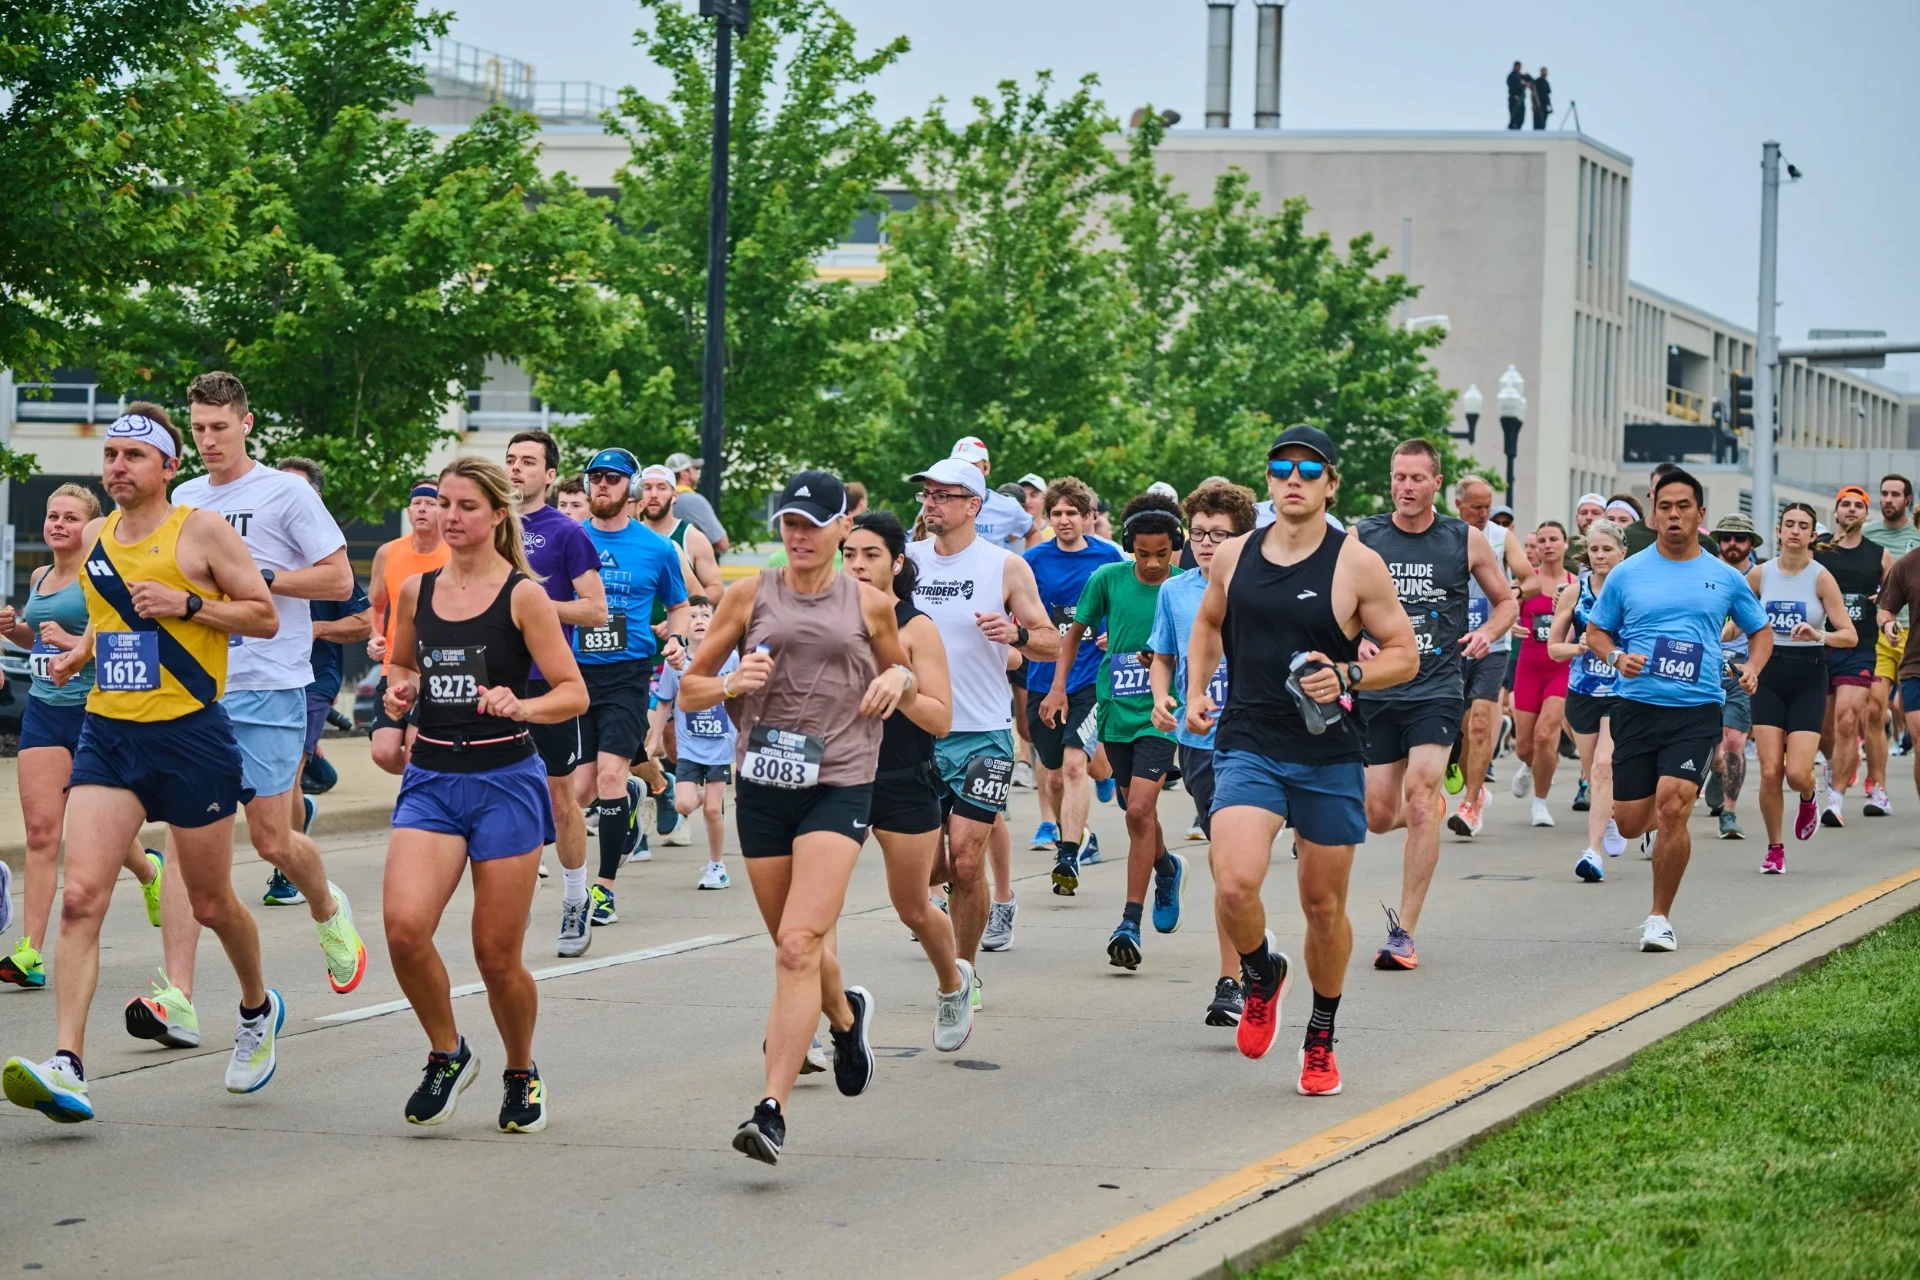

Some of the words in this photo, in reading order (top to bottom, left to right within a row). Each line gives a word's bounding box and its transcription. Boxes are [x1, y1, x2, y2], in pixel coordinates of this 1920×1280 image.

[87, 560, 114, 576] H
[600, 570, 631, 581] ETTI
[915, 586, 959, 597] STRIDERS
[1845, 606, 1861, 618] 65
[1768, 613, 1802, 628] 2463
[585, 631, 619, 648] 8331
[103, 661, 147, 684] 1612
[1659, 657, 1695, 678] 1640
[429, 674, 478, 698] 8273
[691, 720, 723, 733] 1528
[760, 746, 783, 758] CRYSTAL
[783, 751, 806, 762] CASPER
[752, 756, 805, 784] 8083
[972, 777, 1009, 800] 8419
